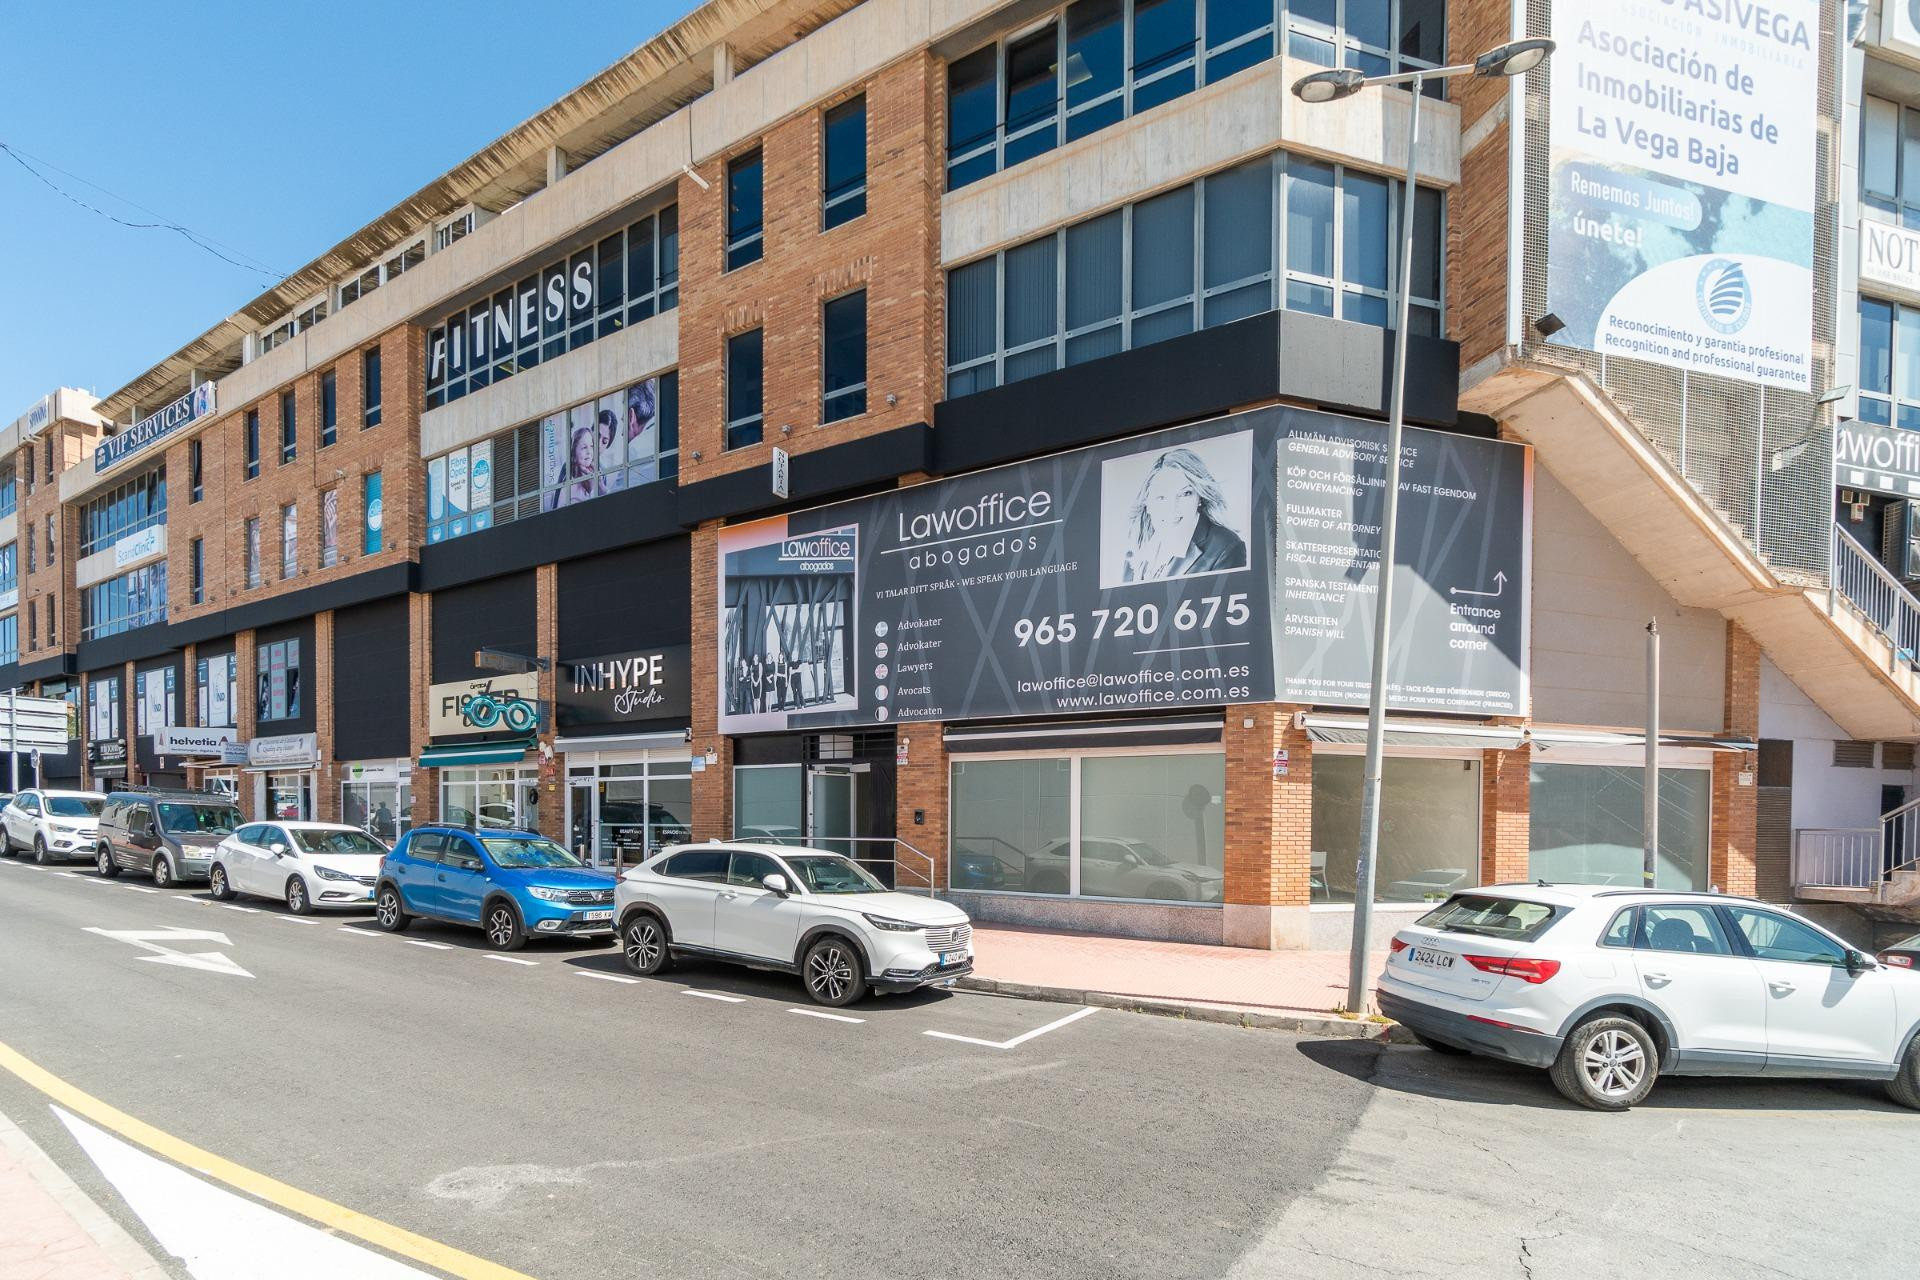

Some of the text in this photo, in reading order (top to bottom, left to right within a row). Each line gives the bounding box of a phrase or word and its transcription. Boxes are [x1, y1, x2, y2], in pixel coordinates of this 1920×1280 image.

[1683, 0, 1810, 51] ASIVEGA
[1577, 20, 1754, 95] Asociación de
[1577, 62, 1779, 144] Inmobiliarias de
[1577, 106, 1740, 177] La Vega Baja
[1570, 170, 1640, 208] Rememos
[1573, 210, 1643, 248] únete!
[1866, 226, 1920, 274] NOT
[431, 261, 593, 381] FITNESS
[1609, 315, 1694, 344] Reconocimiento
[1696, 334, 1703, 347] y
[1748, 346, 1805, 366] profesional
[1605, 333, 1807, 383] Recognition and professional guarantee
[108, 435, 128, 459] VIP
[130, 396, 191, 447] SERVICES
[1288, 430, 1418, 457] ALLMÄN ADVISORISK SVICE
[1288, 442, 1415, 468] GENERAL ADVISORY SEICE
[1287, 466, 1306, 477] KÖP
[1309, 470, 1331, 481] OCH
[1398, 482, 1411, 491] AV
[1412, 484, 1432, 494] FAST
[1433, 487, 1477, 501] EGENDOM
[1287, 479, 1363, 497] CONVEYANCING
[899, 491, 1051, 542] Lawoffice
[1286, 504, 1343, 518] FULLMAKTER
[1286, 516, 1382, 535] POWER OF ATTORNEY
[781, 537, 850, 557] Lawoffice
[909, 536, 1038, 570] abogados
[1285, 540, 1382, 559] SKATTEREPRESENTATIO
[800, 561, 835, 573] abogados
[1285, 553, 1318, 564] FISCAL
[876, 591, 884, 600] VI
[885, 586, 909, 598] TALAR
[910, 584, 928, 595] DITT
[929, 578, 955, 591] SPRÅK
[961, 577, 975, 587] WE
[977, 573, 1003, 585] SPEAK
[1005, 570, 1028, 580] YOUR
[1030, 562, 1078, 576] LANGUAGE
[1285, 577, 1327, 589] SPANSKA
[1285, 589, 1345, 603] INHERITANCE
[1014, 593, 1250, 647] 965 720 675
[1284, 614, 1338, 626] ARVSKIFTEN
[1450, 602, 1501, 619] Entrance
[897, 618, 943, 631] Advokater
[1284, 626, 1345, 639] SPANISH WILL
[1449, 622, 1496, 635] arround
[897, 640, 943, 652] Advokater
[1449, 639, 1489, 651] corner
[574, 654, 664, 694] INHYPE
[897, 662, 934, 674] Lawyers
[1017, 665, 1250, 693] lawoffice@lawoffice.com.es
[1285, 677, 1307, 685] THANK
[614, 685, 665, 714] Studio
[897, 686, 931, 696] Avocats
[1056, 685, 1250, 708] www.lawoffice.com.es
[897, 707, 943, 717] Advocaten
[170, 736, 217, 746] helvetia
[1414, 950, 1436, 964] 2424
